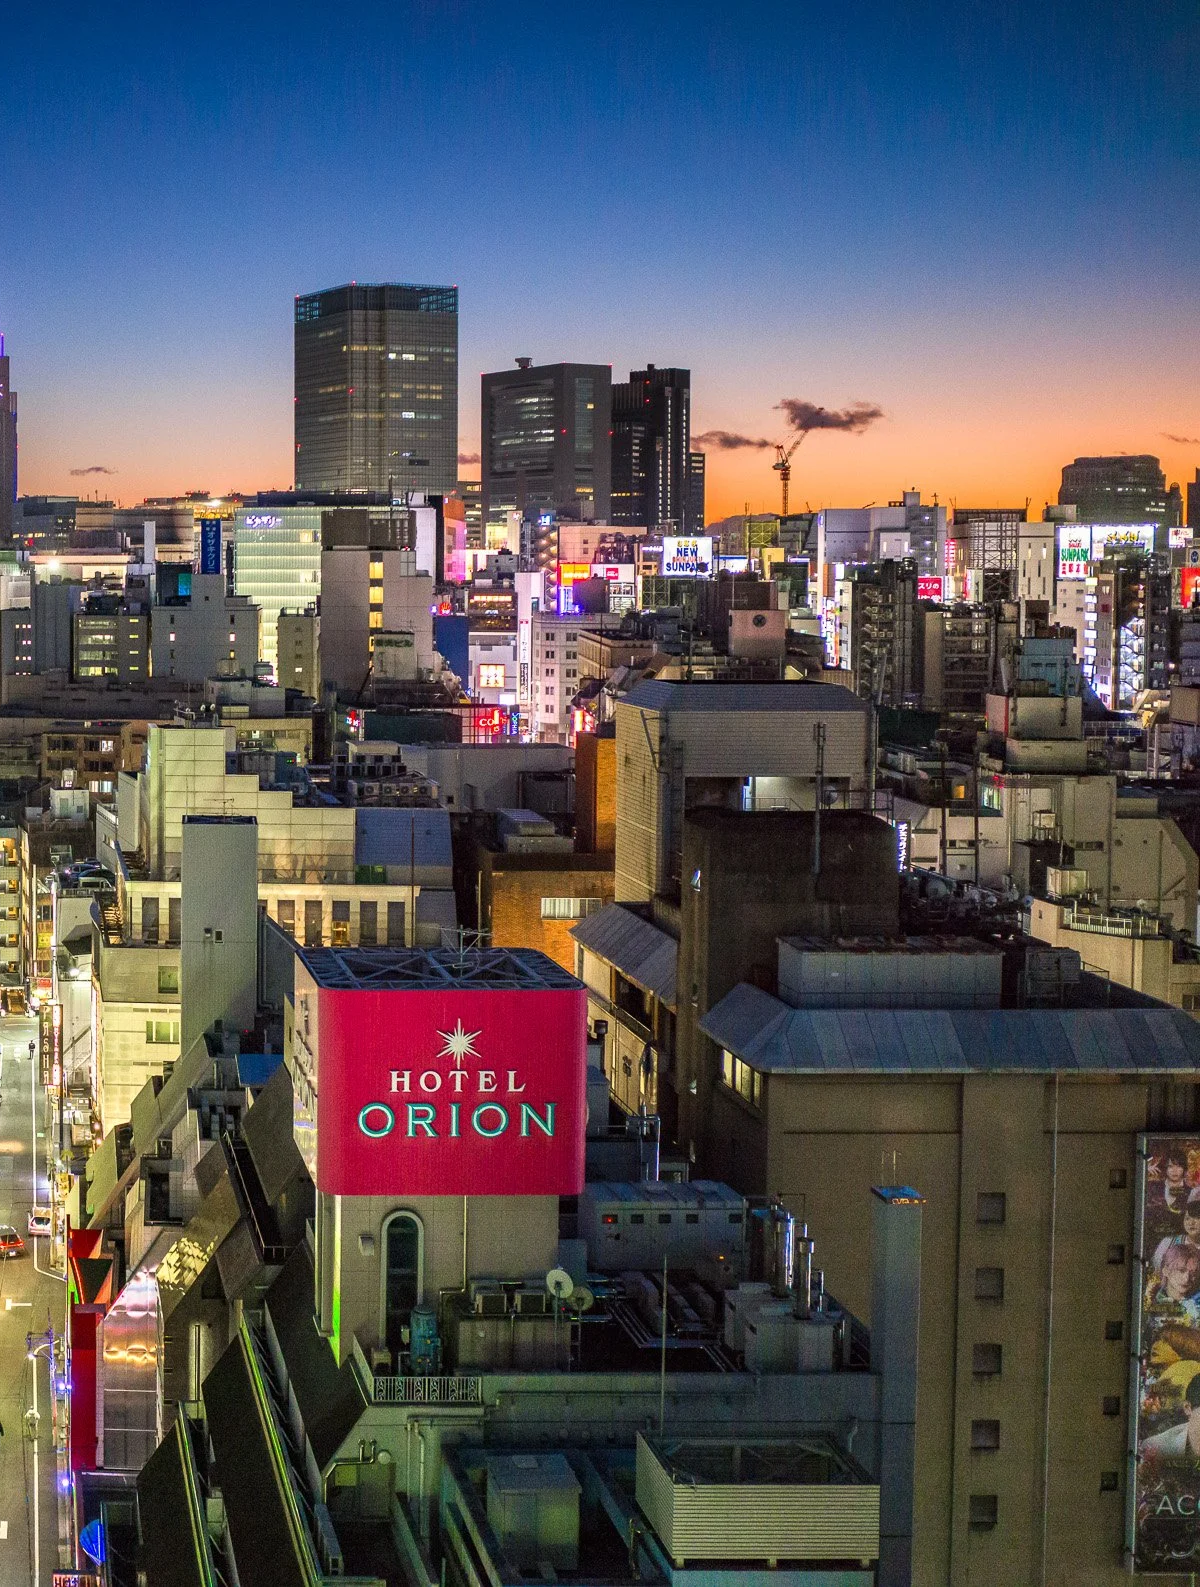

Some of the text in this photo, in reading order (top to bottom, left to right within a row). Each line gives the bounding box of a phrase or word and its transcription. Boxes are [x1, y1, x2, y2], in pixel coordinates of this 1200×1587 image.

[676, 548, 698, 557] NEW
[1061, 548, 1089, 561] SUNPARK
[511, 712, 522, 735] SOPHIA
[389, 1070, 526, 1093] HOTEL
[358, 1102, 557, 1138] ORION
